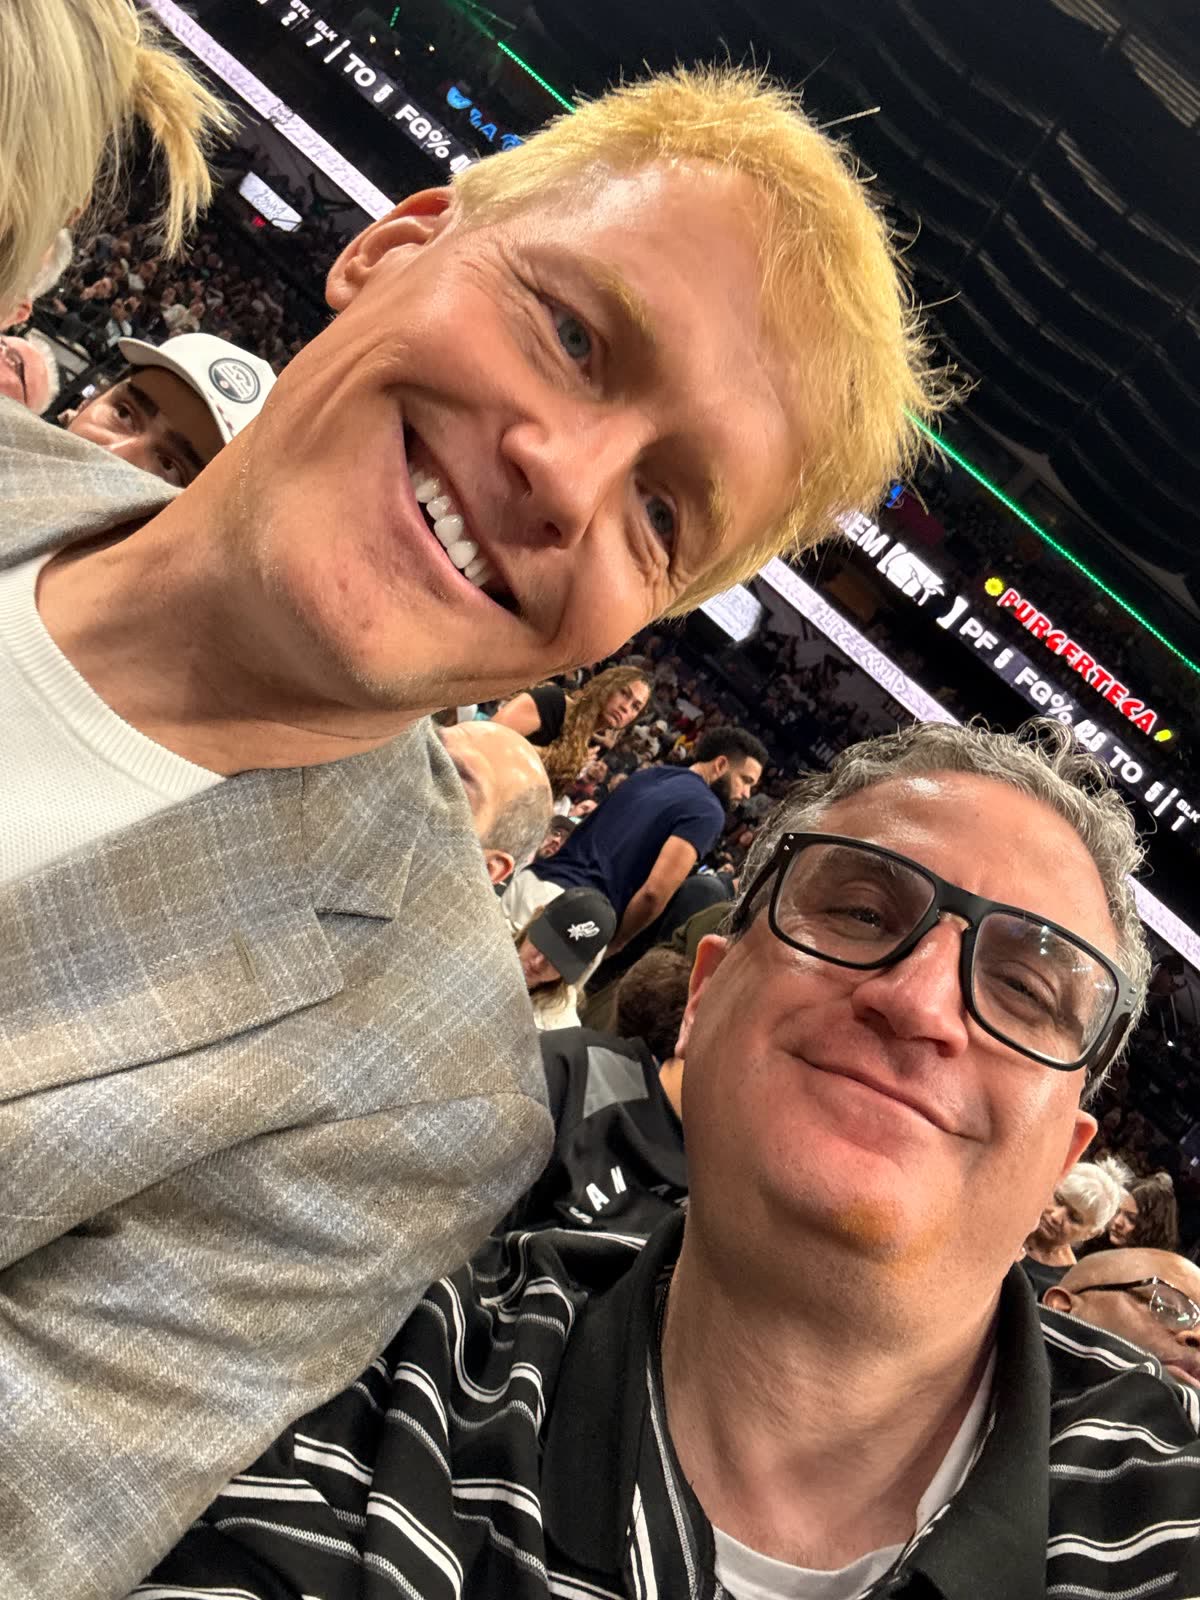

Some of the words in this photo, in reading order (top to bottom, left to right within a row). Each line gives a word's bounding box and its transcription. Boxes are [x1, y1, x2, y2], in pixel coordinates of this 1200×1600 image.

[314, 20, 338, 42] BLK
[281, 11, 298, 26] 2
[343, 53, 377, 87] TO
[395, 104, 451, 159] FG%
[959, 617, 998, 650] PF
[1014, 666, 1073, 725] FG%
[1109, 745, 1143, 784] TO
[568, 1165, 627, 1225] SAN
